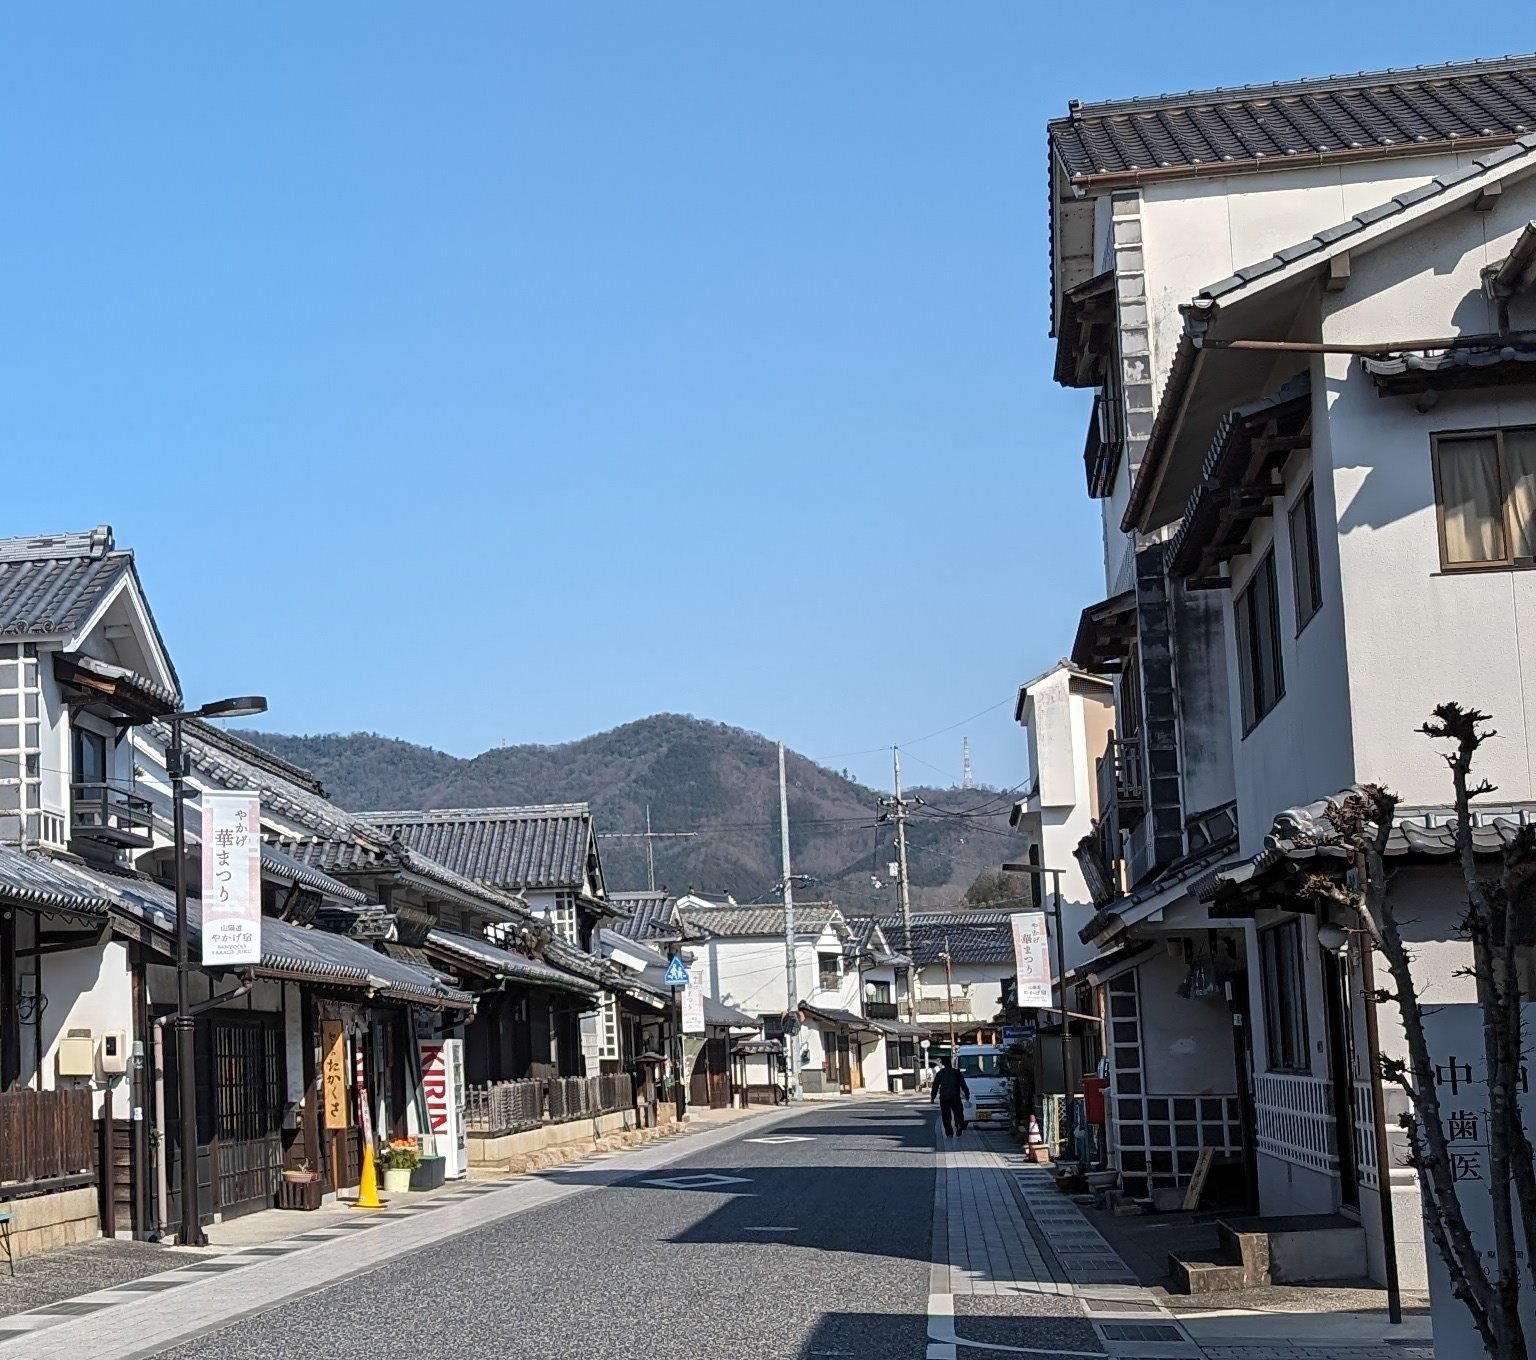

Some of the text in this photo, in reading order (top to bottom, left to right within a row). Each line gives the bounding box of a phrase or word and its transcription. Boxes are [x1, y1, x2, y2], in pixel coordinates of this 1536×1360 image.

[214, 828, 234, 903] 華まつり
[235, 809, 248, 847] やかげ
[421, 1045, 448, 1136] KIRIN
